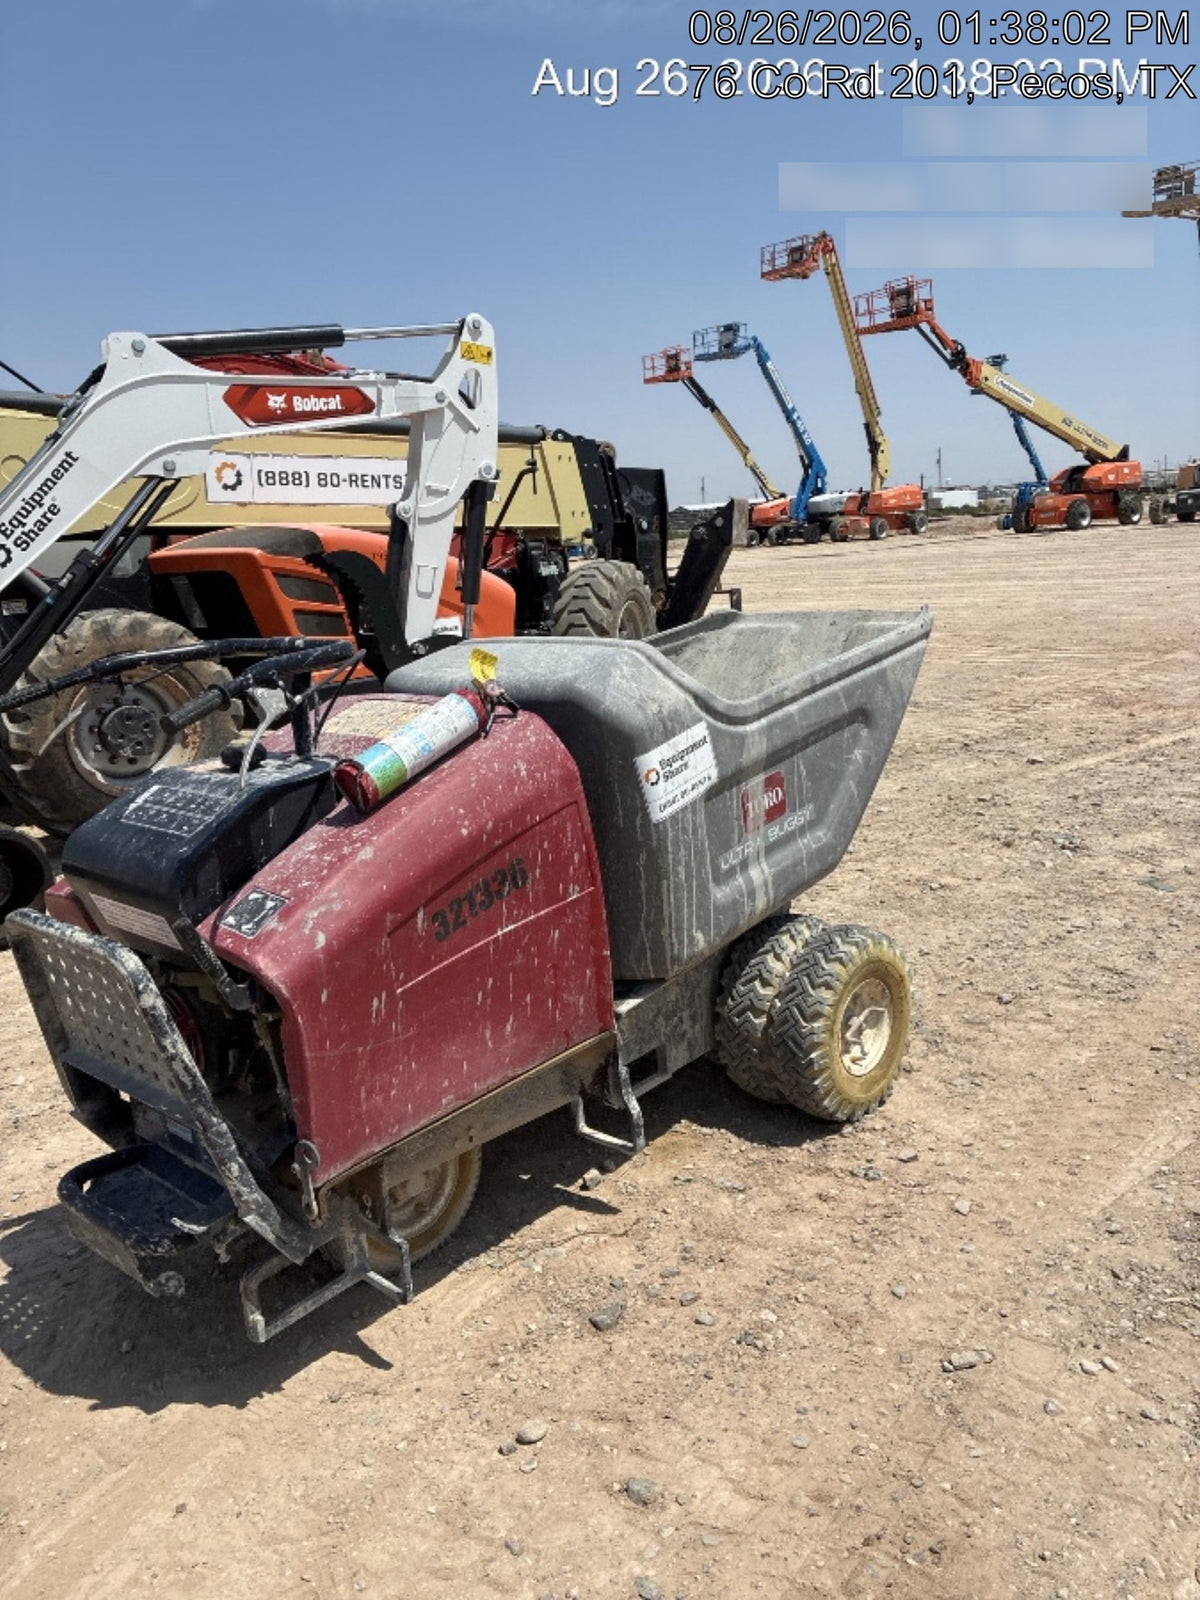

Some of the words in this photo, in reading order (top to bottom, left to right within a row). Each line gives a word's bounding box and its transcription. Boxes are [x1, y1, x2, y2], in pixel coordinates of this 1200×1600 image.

[293, 395, 345, 412] Bobcat
[0, 451, 79, 539] Equipment
[257, 469, 310, 487] (888)
[13, 503, 61, 552] Share
[720, 837, 761, 869] ULTR
[431, 858, 529, 942] 321336
